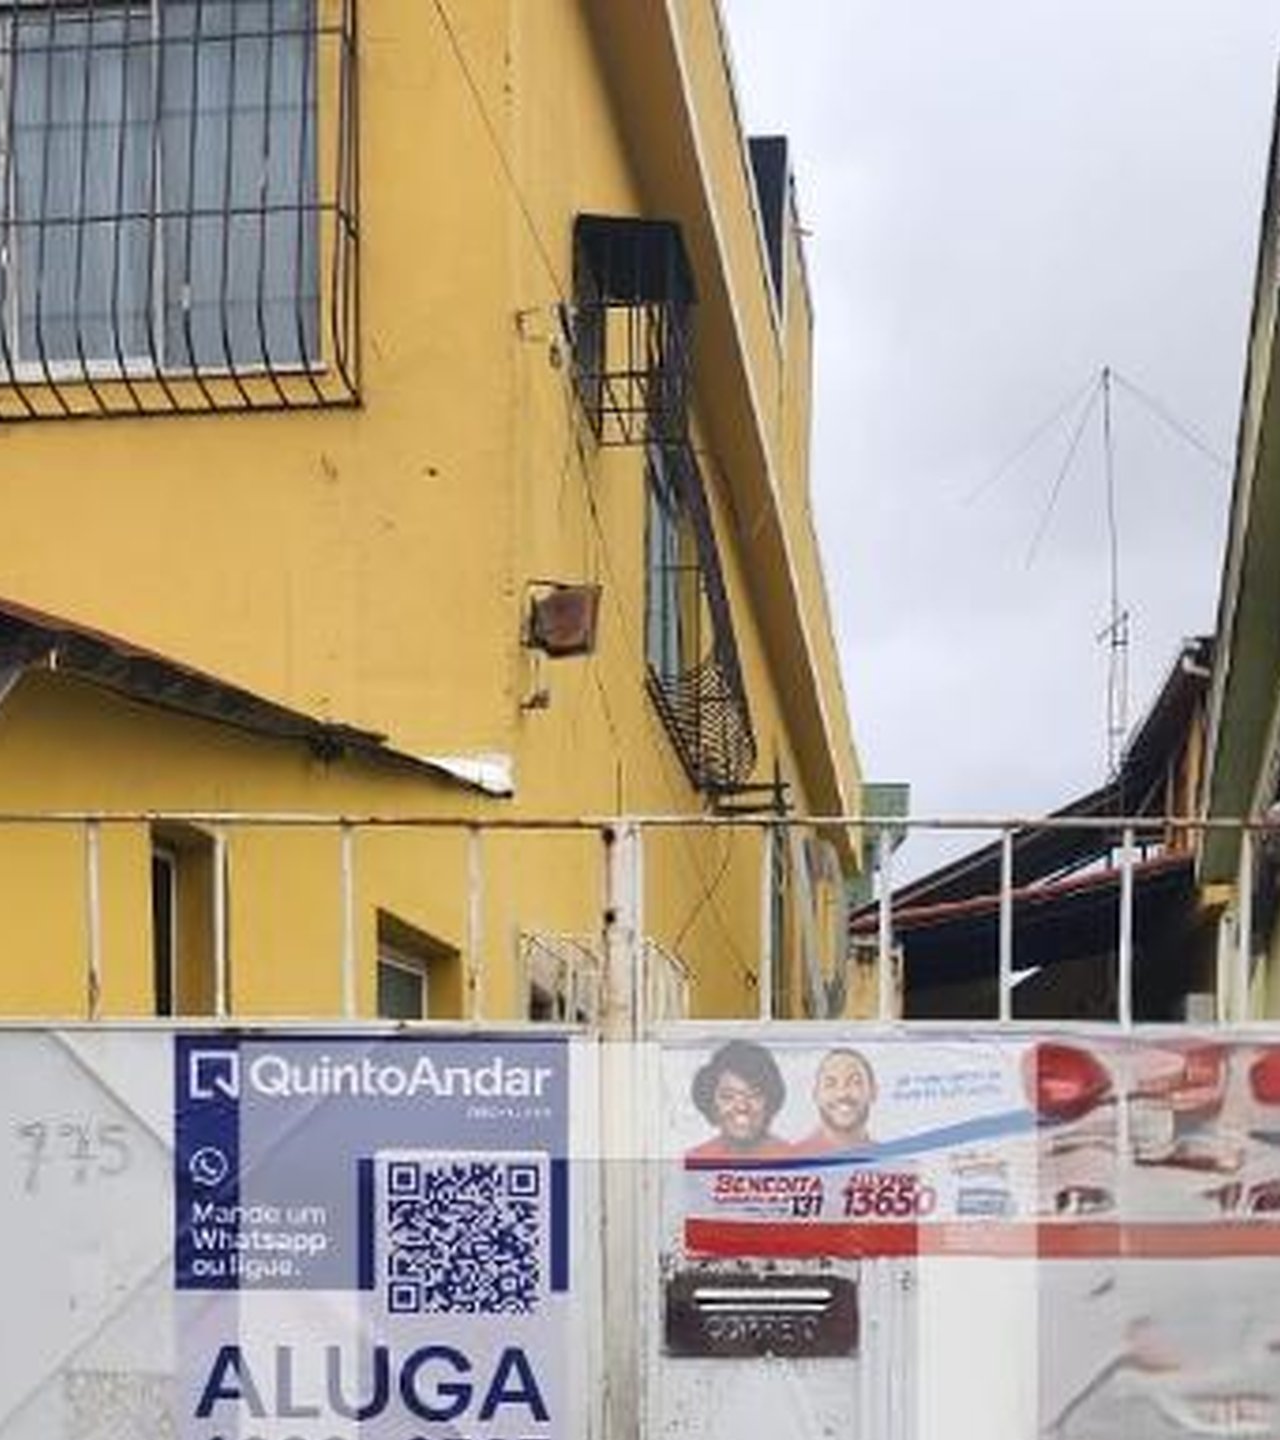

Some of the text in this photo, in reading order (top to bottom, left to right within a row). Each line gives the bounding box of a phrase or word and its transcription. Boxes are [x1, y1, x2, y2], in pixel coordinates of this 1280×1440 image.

[249, 1055, 552, 1098] QuintoAndar
[286, 1206, 327, 1225] um
[841, 1186, 938, 1219] 13650
[191, 1227, 328, 1257] Whatsapp
[191, 1258, 226, 1276] ou
[194, 1345, 551, 1423] ALUGA
